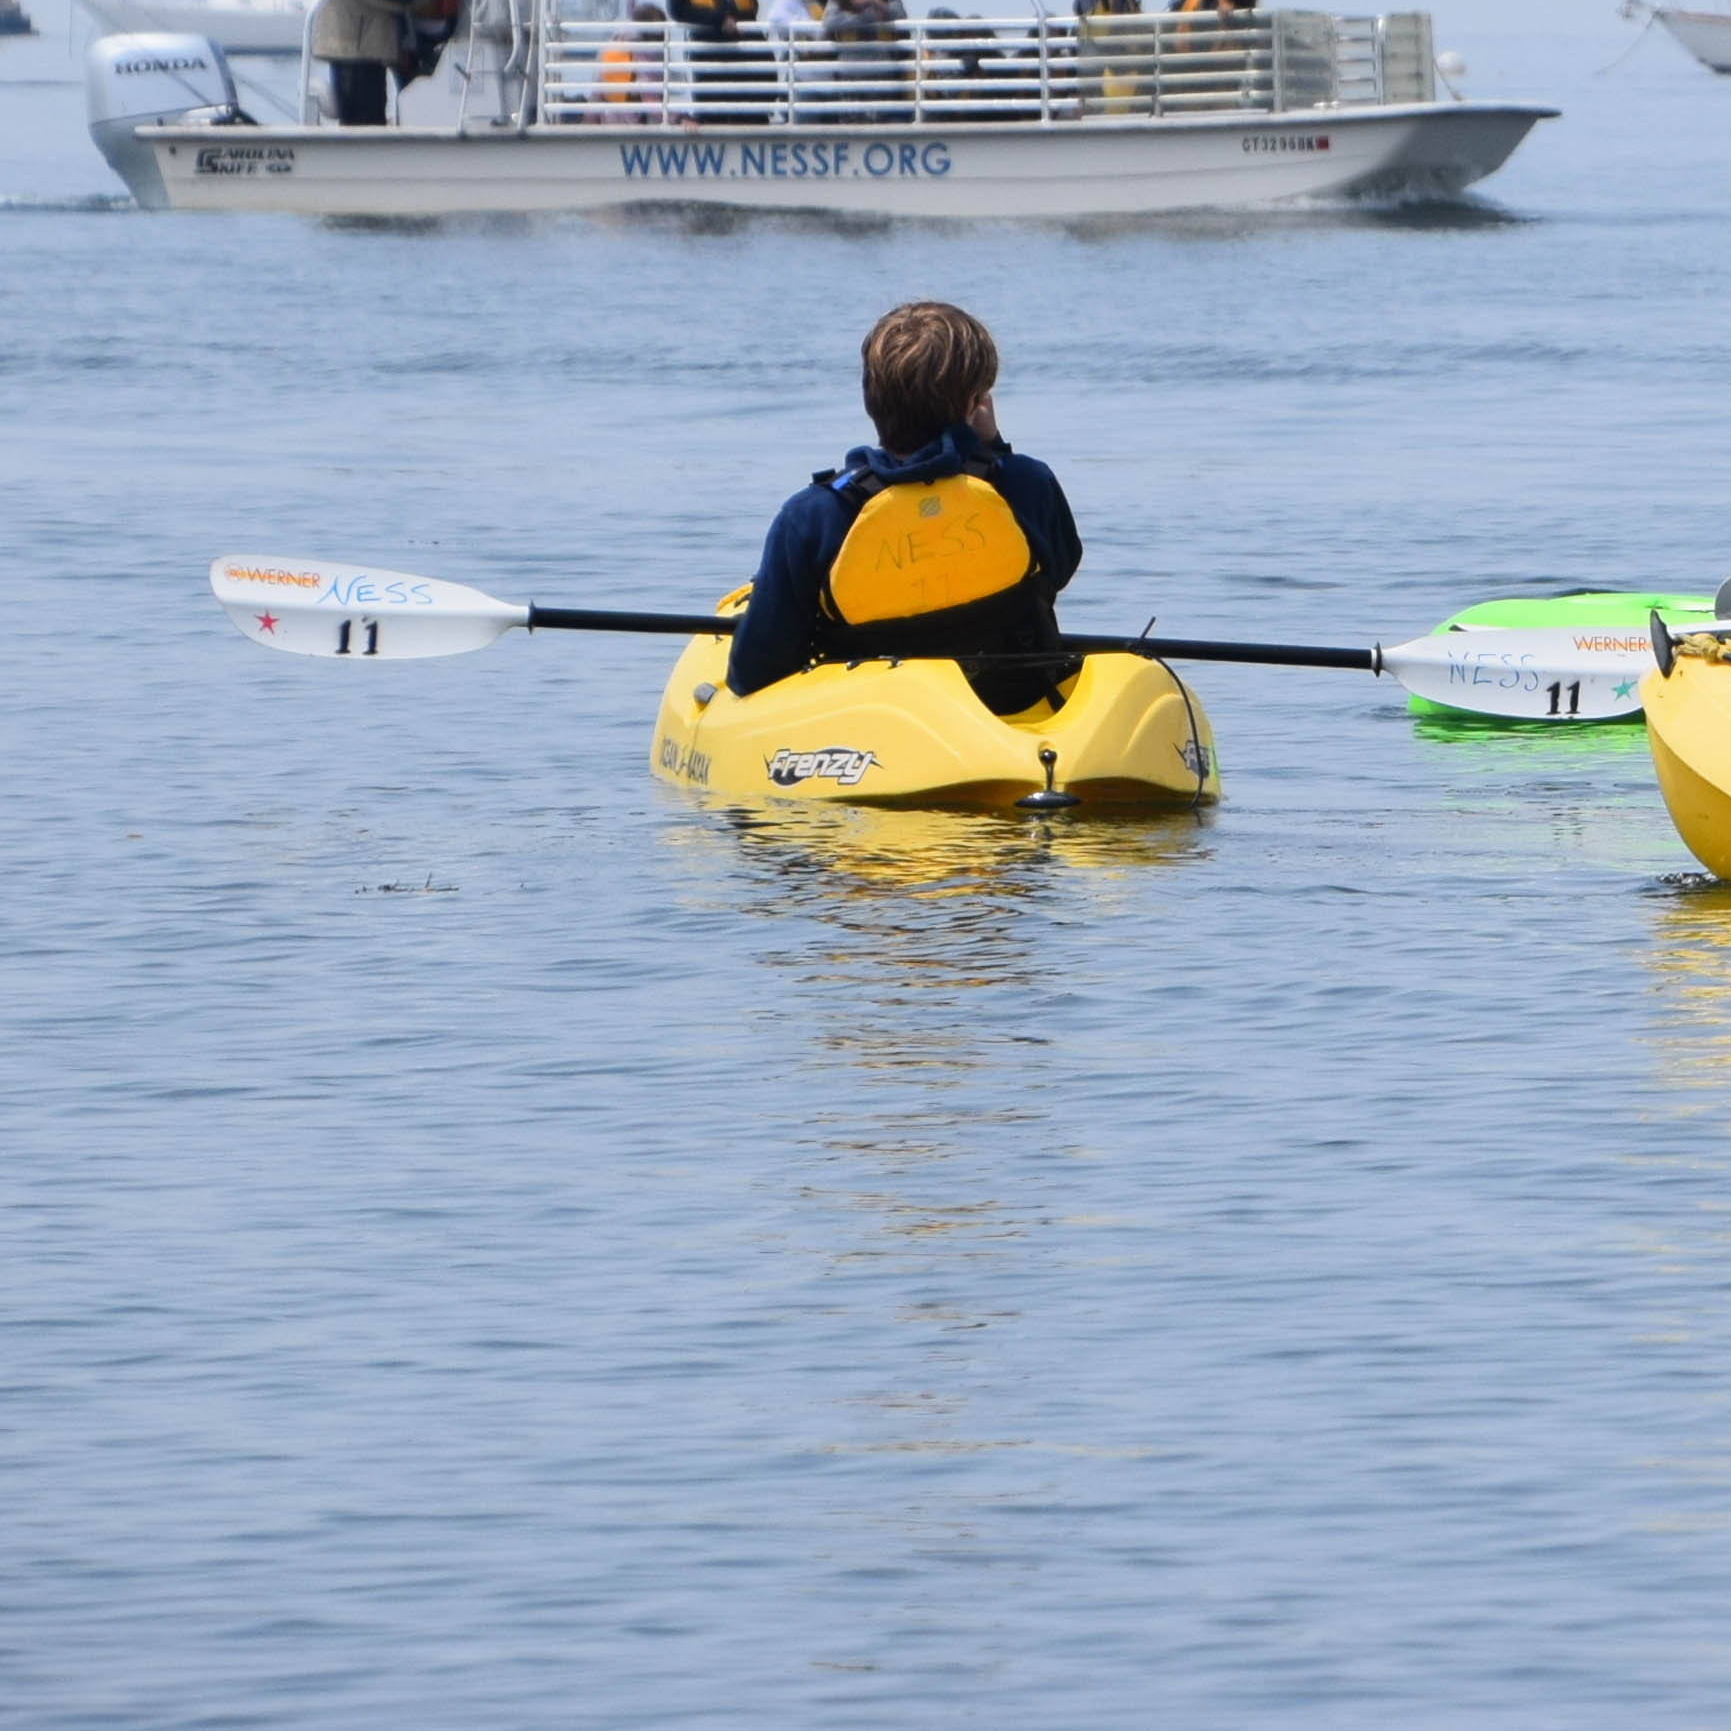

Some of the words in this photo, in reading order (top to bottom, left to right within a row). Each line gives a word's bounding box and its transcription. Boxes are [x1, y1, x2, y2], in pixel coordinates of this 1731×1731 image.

[114, 57, 207, 75] HONDA
[619, 142, 951, 177] WWW.NESSF.ORG
[874, 512, 986, 573] NESS
[246, 568, 320, 589] WERNER
[316, 576, 433, 606] NESS
[335, 618, 378, 655] 11
[1573, 636, 1646, 653] WERNER
[1447, 650, 1541, 692] NESS
[1546, 680, 1581, 716] 11
[768, 748, 878, 786] Frenzy
